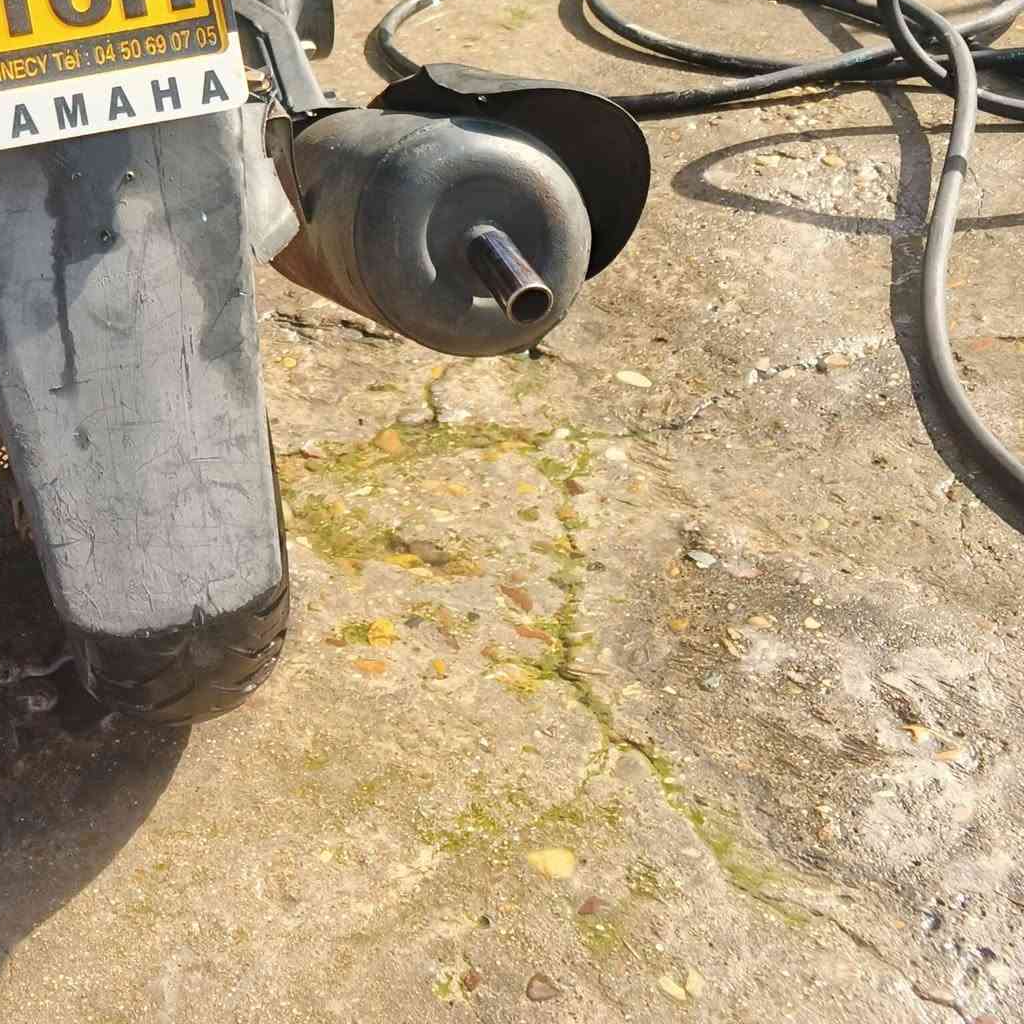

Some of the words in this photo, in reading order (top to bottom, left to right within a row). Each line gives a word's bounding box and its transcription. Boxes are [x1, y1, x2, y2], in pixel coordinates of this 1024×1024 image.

[95, 44, 116, 65] 04
[120, 39, 141, 60] 50
[145, 34, 167, 56] 69
[170, 29, 191, 52] 07
[195, 25, 218, 47] 05
